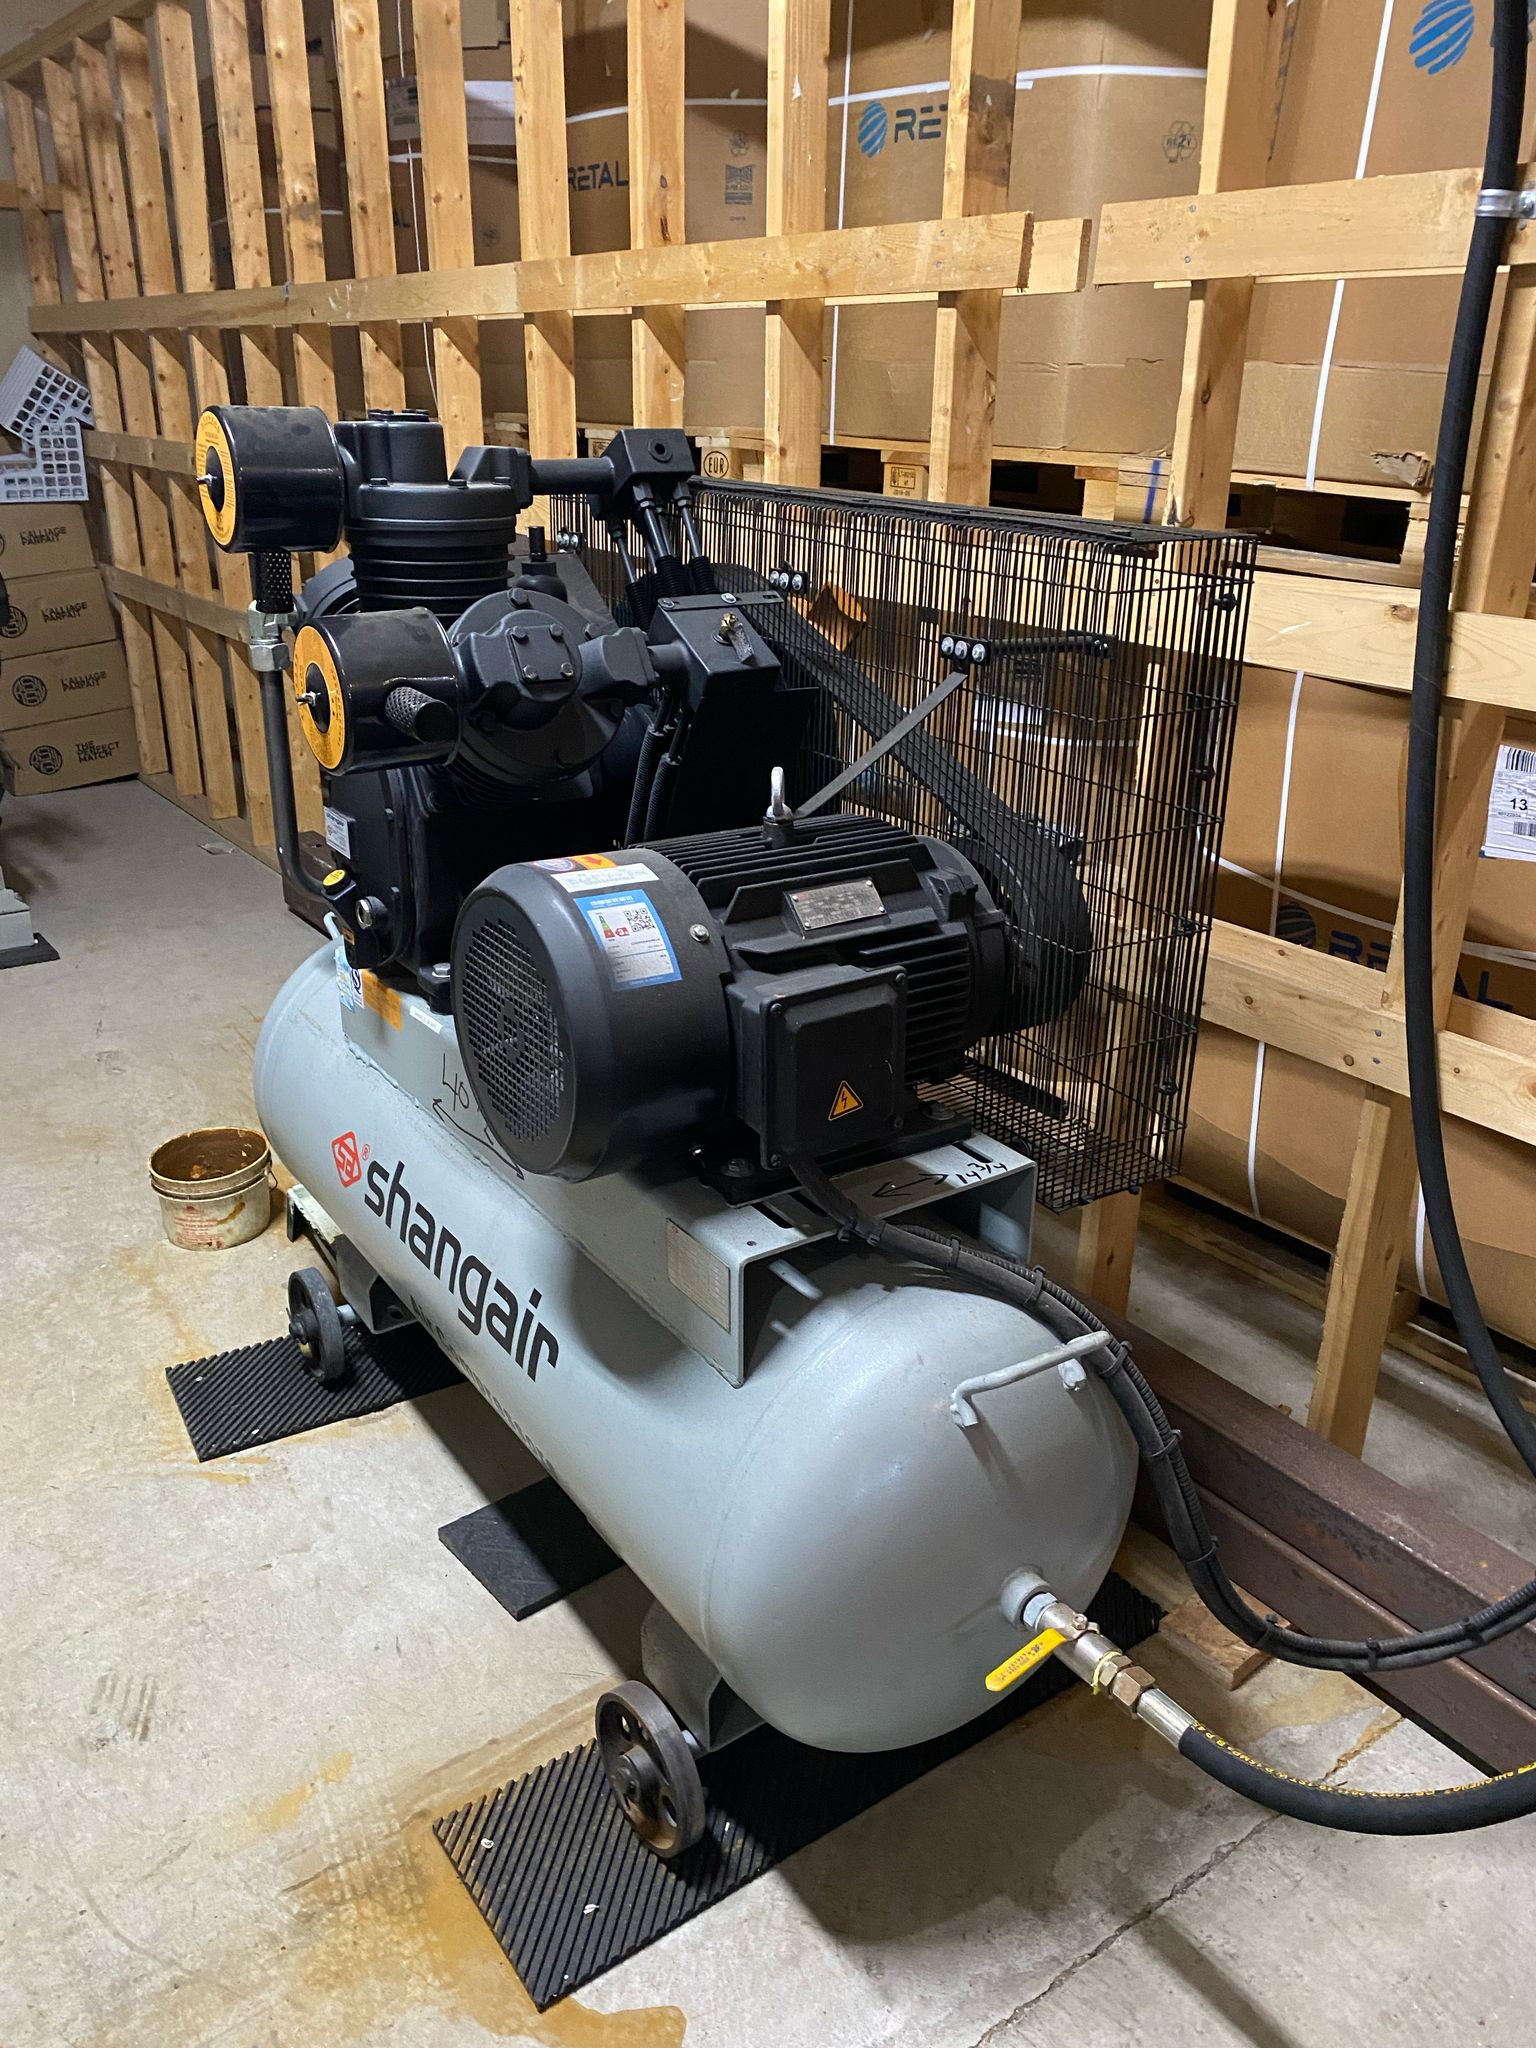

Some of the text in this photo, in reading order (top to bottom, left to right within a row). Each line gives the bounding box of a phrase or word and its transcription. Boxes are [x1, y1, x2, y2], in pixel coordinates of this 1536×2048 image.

[708, 456, 725, 473] EUR
[79, 750, 113, 763] MATCH
[1510, 797, 1528, 811] 13
[364, 1160, 560, 1383] shangair
